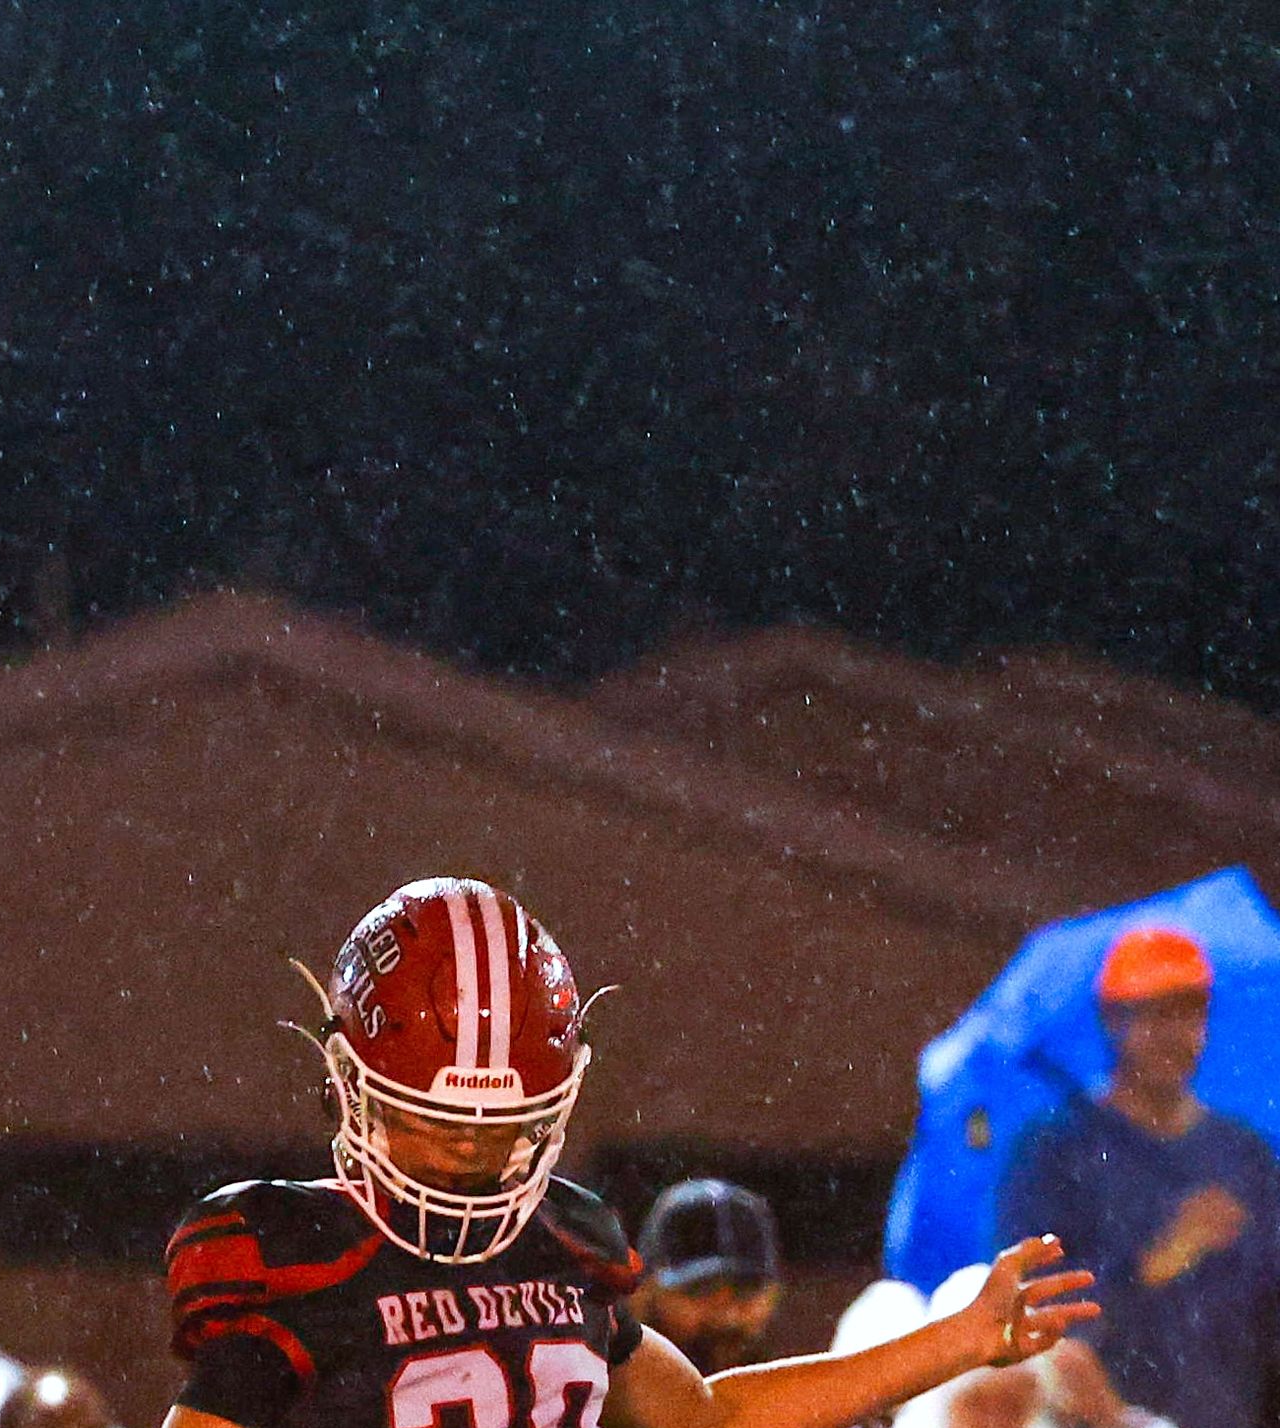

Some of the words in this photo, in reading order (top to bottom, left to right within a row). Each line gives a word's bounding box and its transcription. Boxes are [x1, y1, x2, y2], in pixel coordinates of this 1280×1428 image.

[445, 1072, 514, 1089] Riddell
[377, 1289, 466, 1345] RED
[466, 1281, 585, 1330] DEVILS
